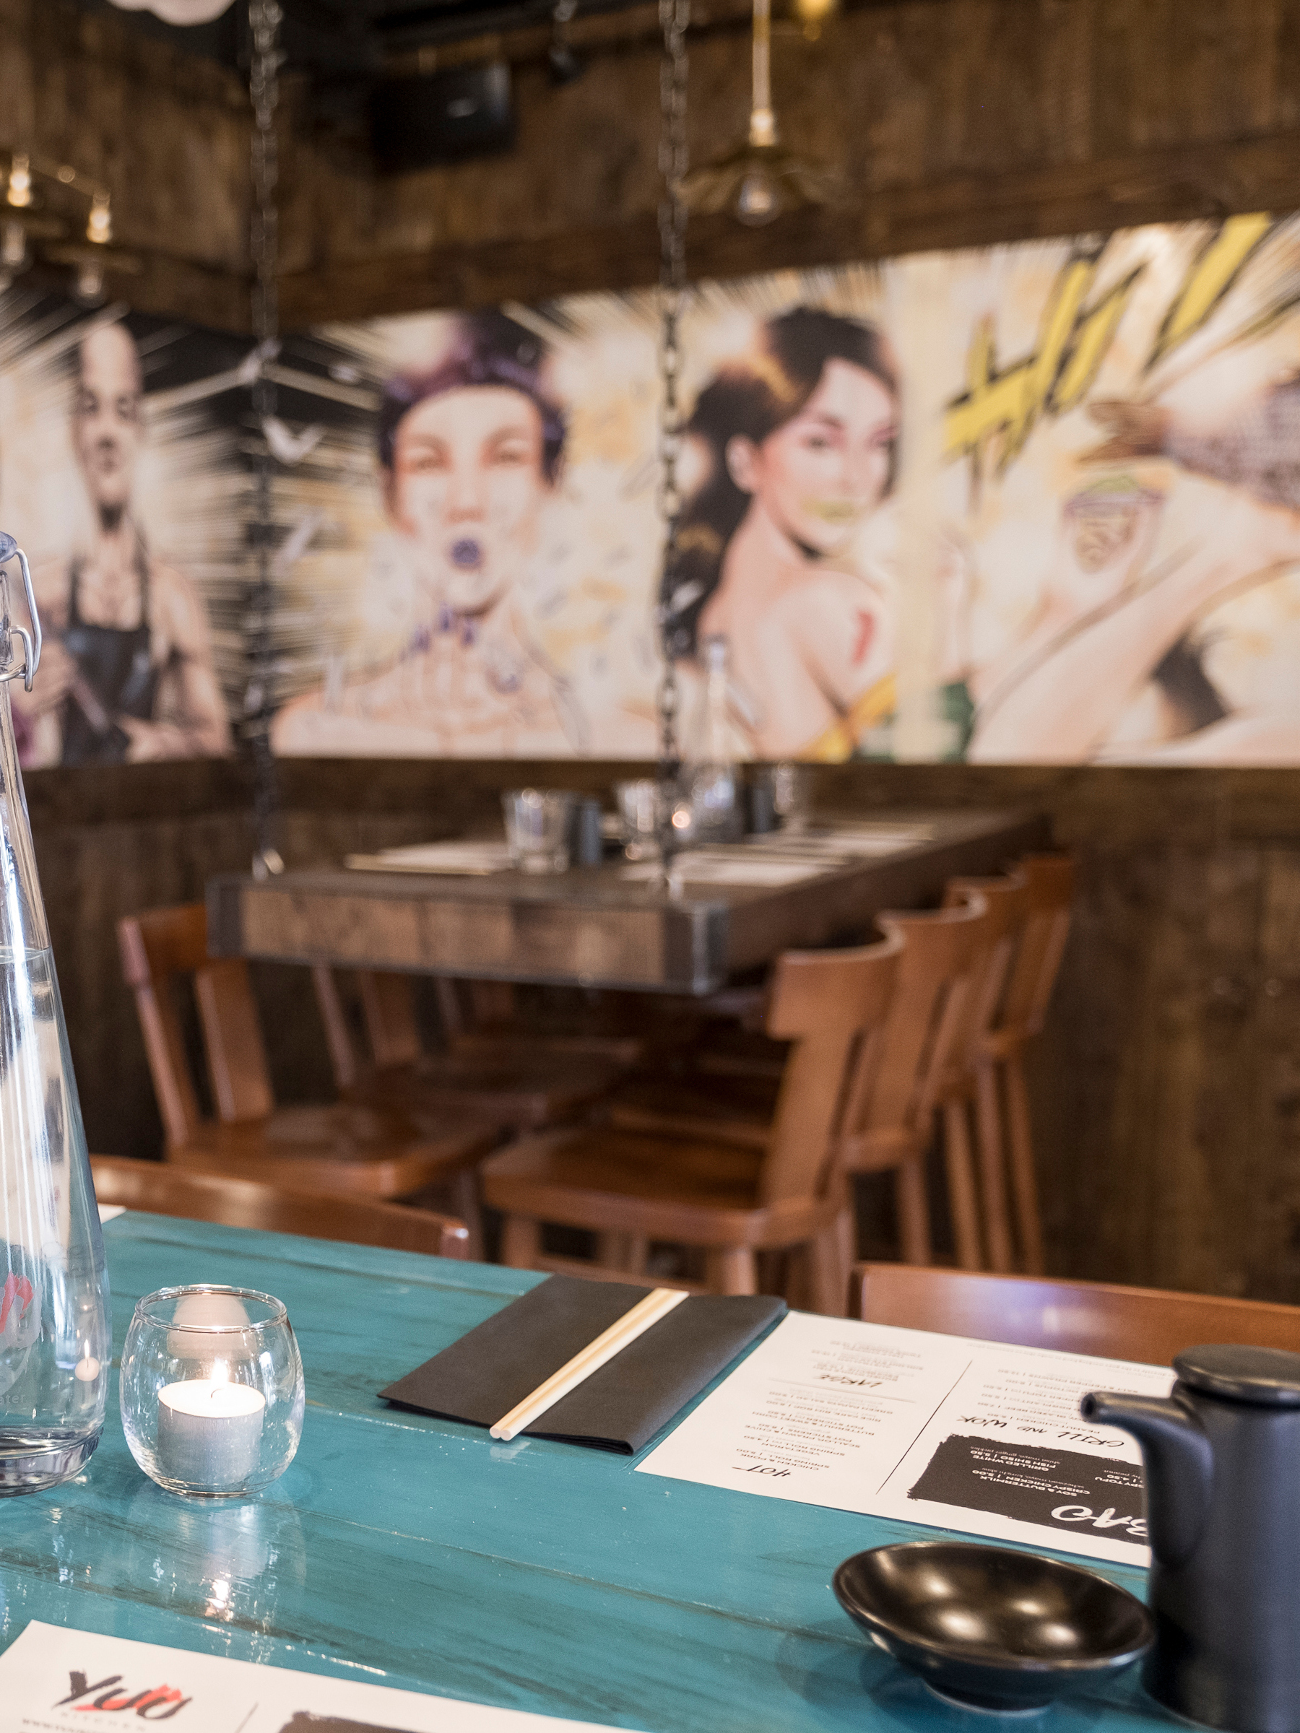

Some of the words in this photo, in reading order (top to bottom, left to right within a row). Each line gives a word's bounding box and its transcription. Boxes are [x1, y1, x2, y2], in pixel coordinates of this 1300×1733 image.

[820, 1375, 882, 1388] LARGE
[964, 1417, 1008, 1428] WOK
[1057, 1431, 1125, 1447] GRILL
[761, 1442, 820, 1456] VEGETARIAN
[741, 1453, 767, 1461] PORK
[972, 1454, 1006, 1465] WHITE
[1000, 1455, 1029, 1465] SHISO
[777, 1460, 819, 1471] CHICKEN
[1006, 1460, 1050, 1472] GRILLED
[1030, 1460, 1056, 1468] FISH
[732, 1465, 791, 1477] HOT
[972, 1469, 994, 1478] 5.00
[980, 1475, 1046, 1491] BUTTERMILK
[1005, 1475, 1052, 1488] CHICKEN
[1094, 1476, 1119, 1484] TOFU
[1053, 1484, 1090, 1495] CRISPY
[1057, 1489, 1078, 1497] SOY
